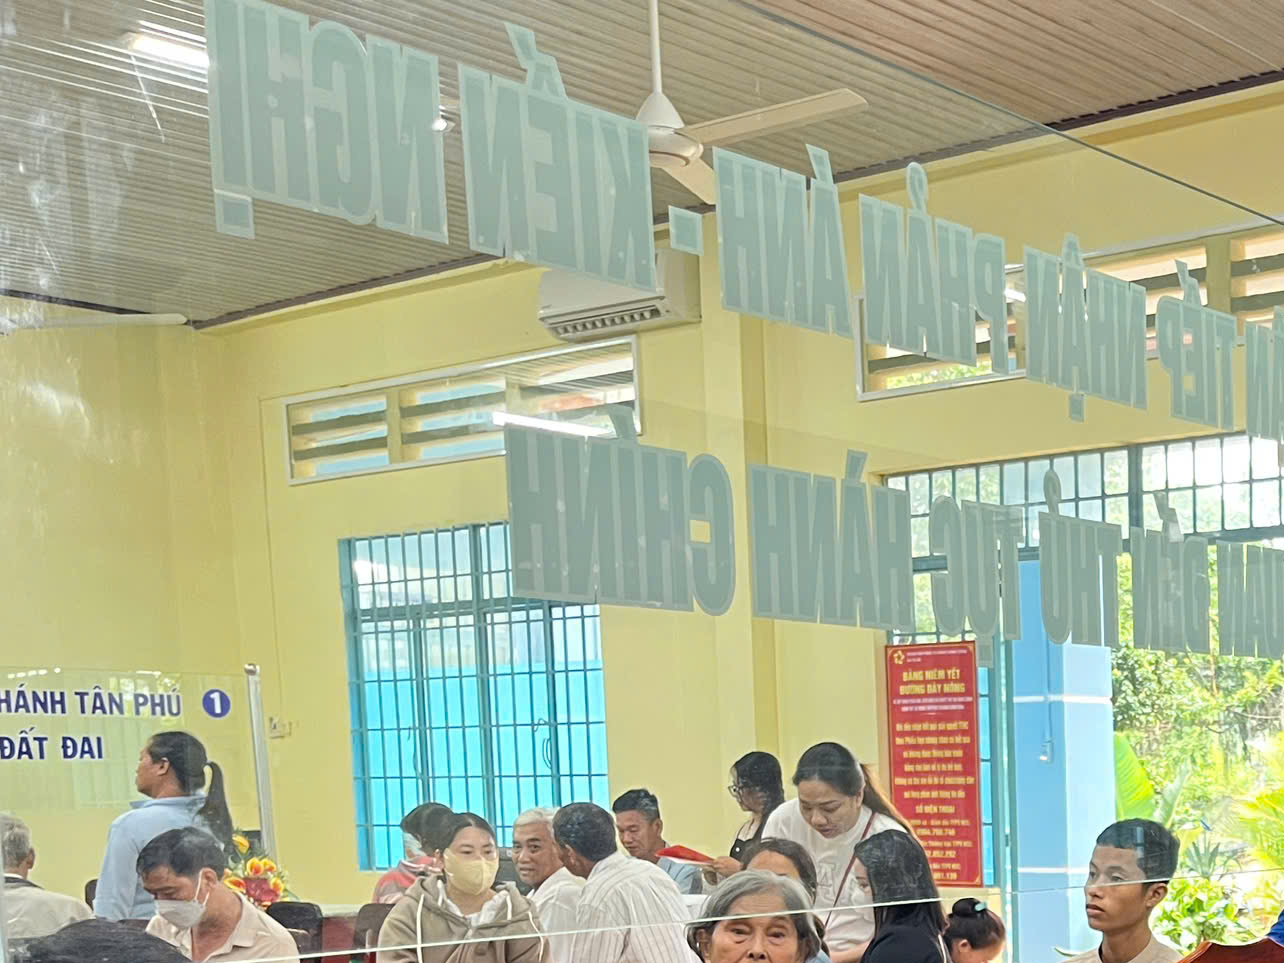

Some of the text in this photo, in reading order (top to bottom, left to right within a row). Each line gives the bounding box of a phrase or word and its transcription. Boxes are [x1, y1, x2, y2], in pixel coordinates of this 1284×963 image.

[74, 686, 125, 716] TÂN
[134, 687, 181, 717] PHÚ
[0, 727, 104, 760] ĐẤT ĐAI
